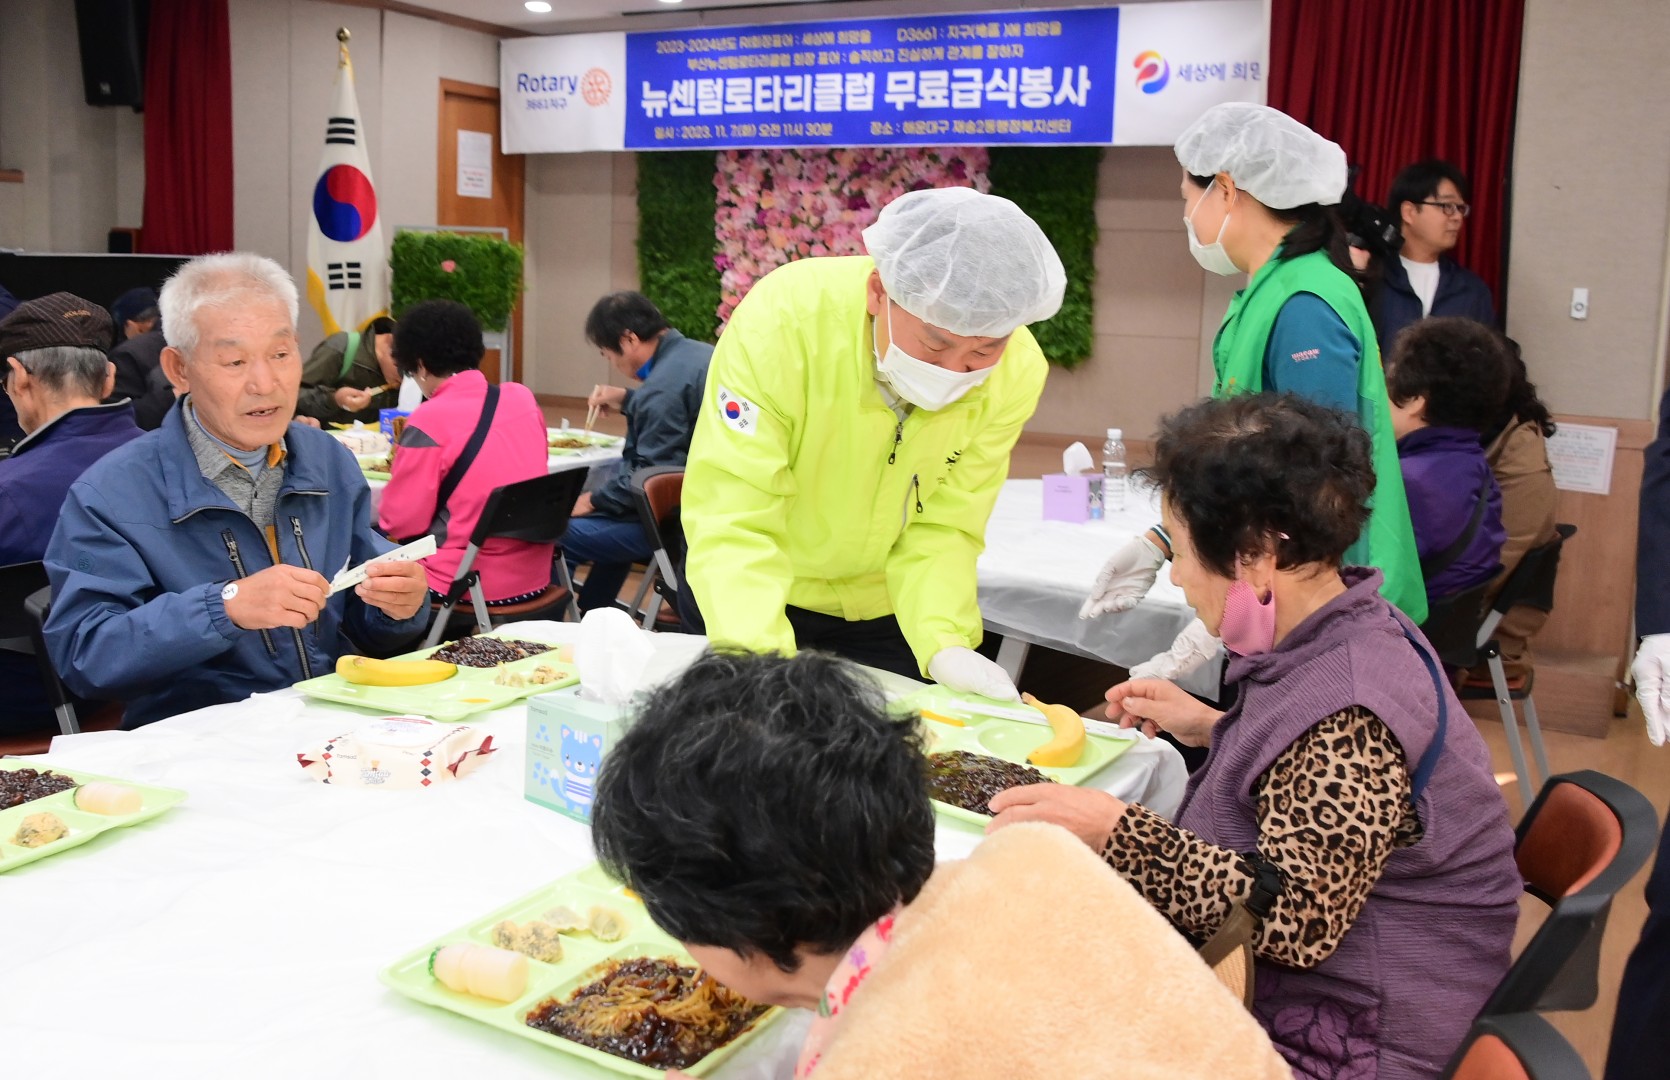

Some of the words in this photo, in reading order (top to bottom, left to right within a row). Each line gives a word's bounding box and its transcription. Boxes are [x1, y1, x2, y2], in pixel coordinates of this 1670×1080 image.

[897, 25, 937, 42] D3661
[1177, 62, 1227, 82] 세상에
[517, 72, 578, 95] Rotary
[641, 71, 875, 118] 뉴센텀로타리클럽
[884, 65, 1092, 111] 무료급식봉사
